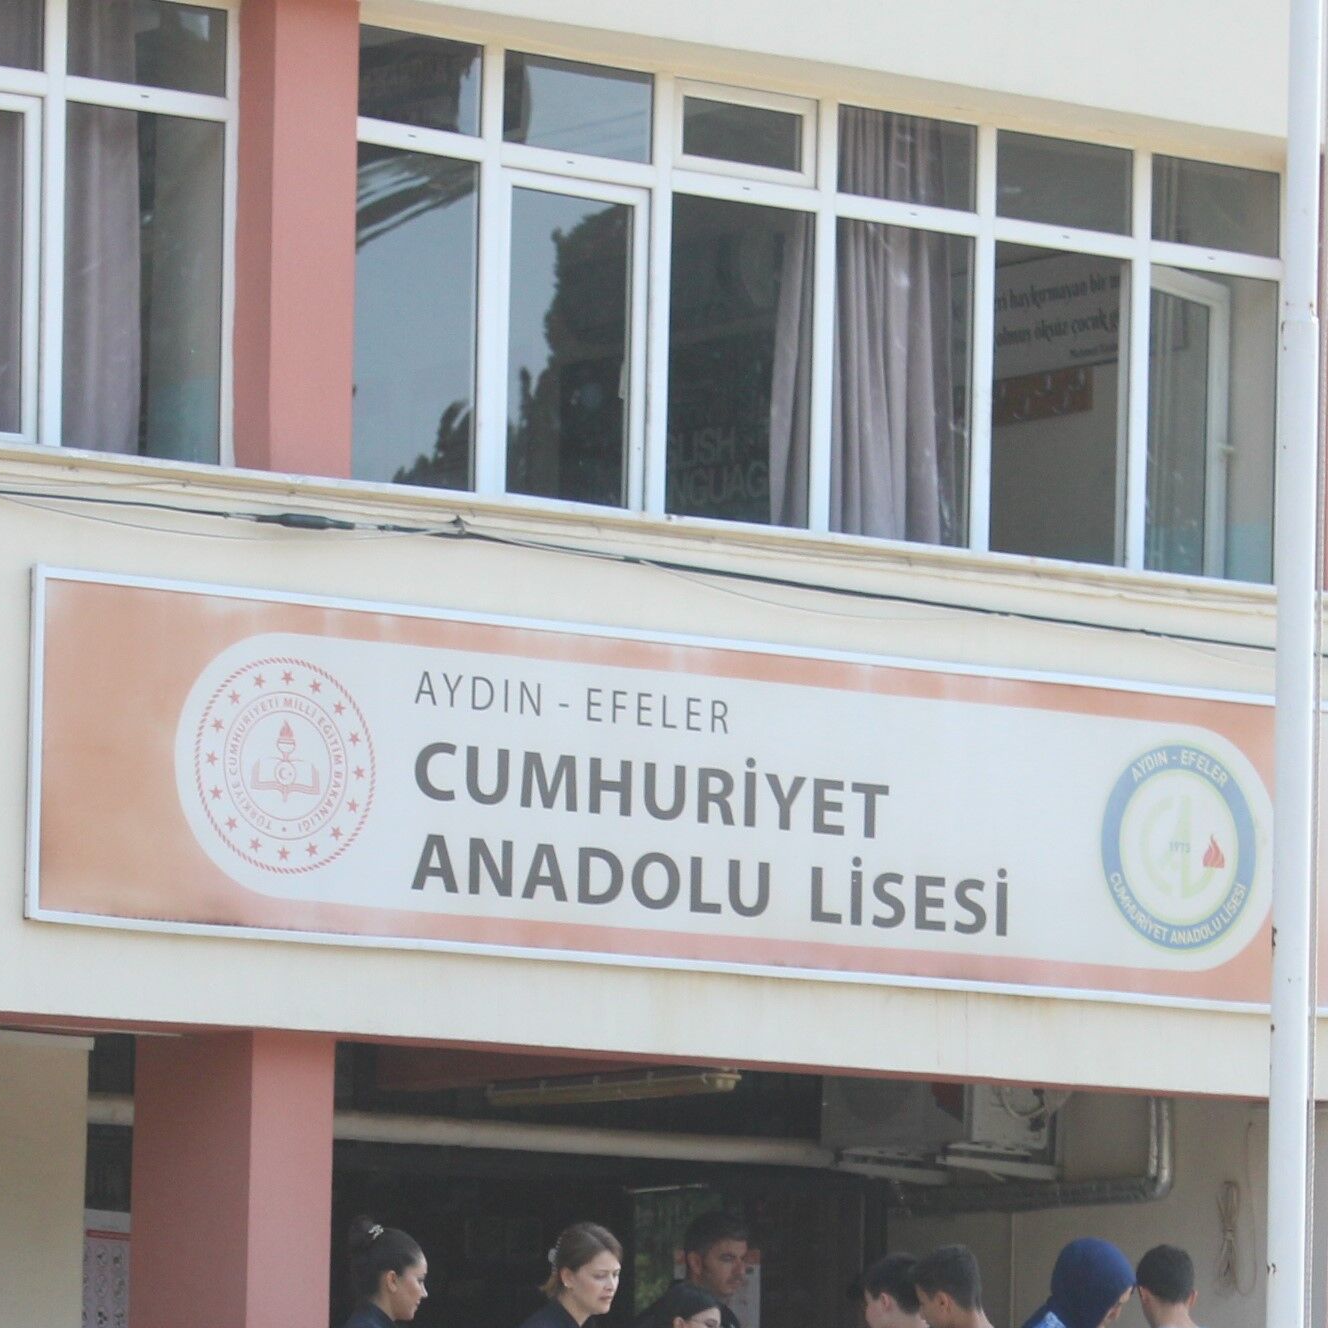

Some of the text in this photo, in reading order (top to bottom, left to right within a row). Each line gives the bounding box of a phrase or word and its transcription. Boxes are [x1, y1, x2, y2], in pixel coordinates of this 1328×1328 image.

[414, 670, 543, 717] AYDIN
[586, 687, 730, 735] EFELER
[413, 741, 891, 839] CUMHURİYET
[1130, 751, 1168, 782] AYDIN
[1180, 750, 1228, 785] EFELER
[410, 833, 1009, 938] ANADOLU LİSESİ
[1169, 919, 1222, 945] ANADOLU
